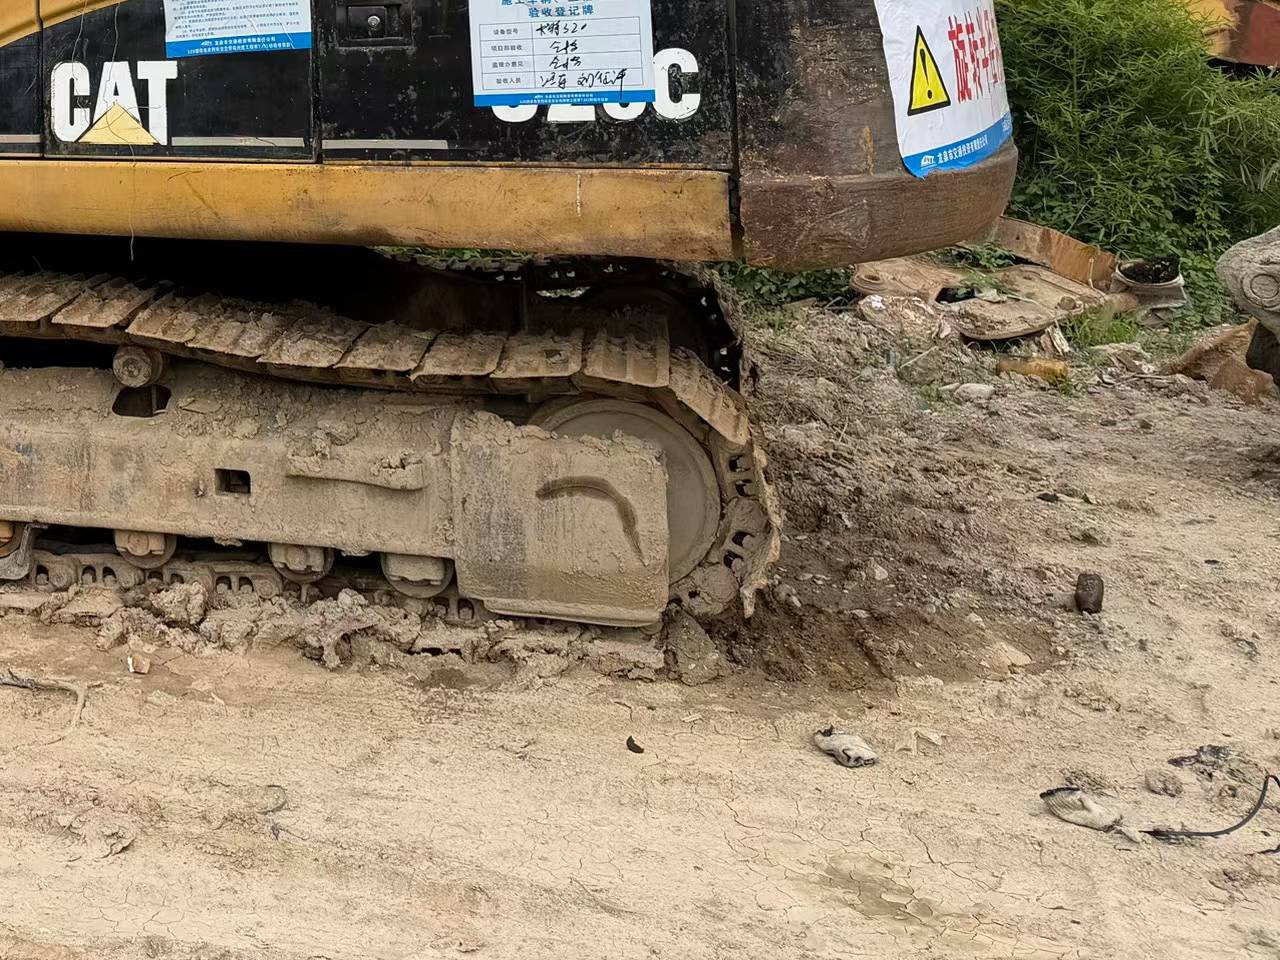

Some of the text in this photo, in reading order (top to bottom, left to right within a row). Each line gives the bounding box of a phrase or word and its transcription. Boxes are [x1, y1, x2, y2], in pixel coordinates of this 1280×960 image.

[528, 6, 595, 19] 验收登记牌
[50, 61, 178, 147] CAT
